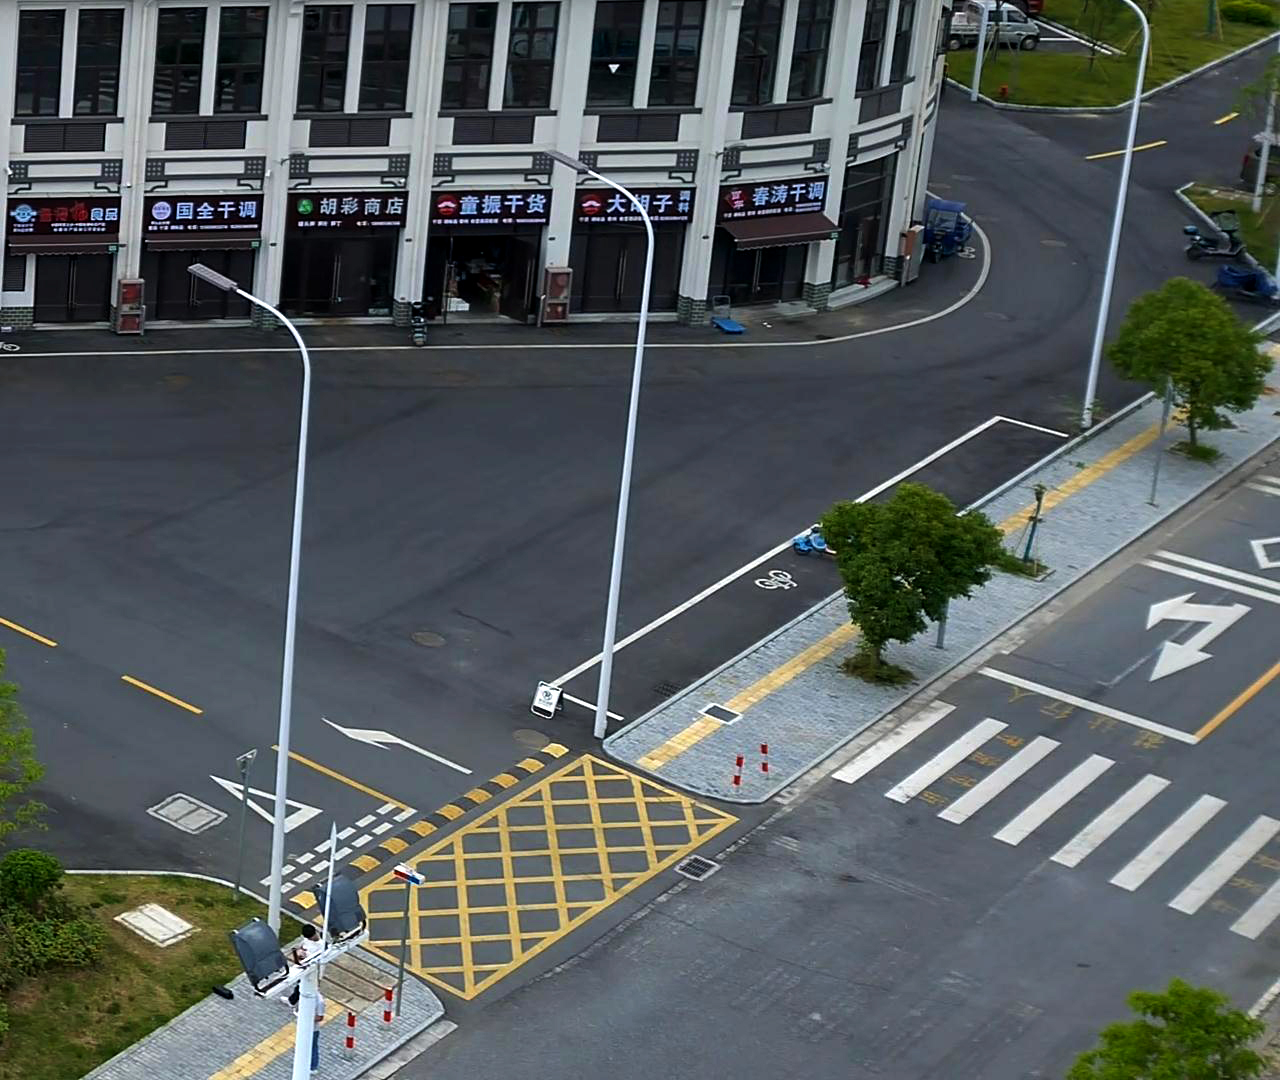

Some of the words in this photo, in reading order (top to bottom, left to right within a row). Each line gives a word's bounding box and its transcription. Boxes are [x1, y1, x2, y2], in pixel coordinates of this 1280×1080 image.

[459, 194, 547, 215] 童振干货
[606, 193, 673, 214] 大胡子
[752, 181, 826, 207] 春涛干调
[176, 201, 257, 220] 国全干调
[320, 197, 404, 216] 胡彩商店
